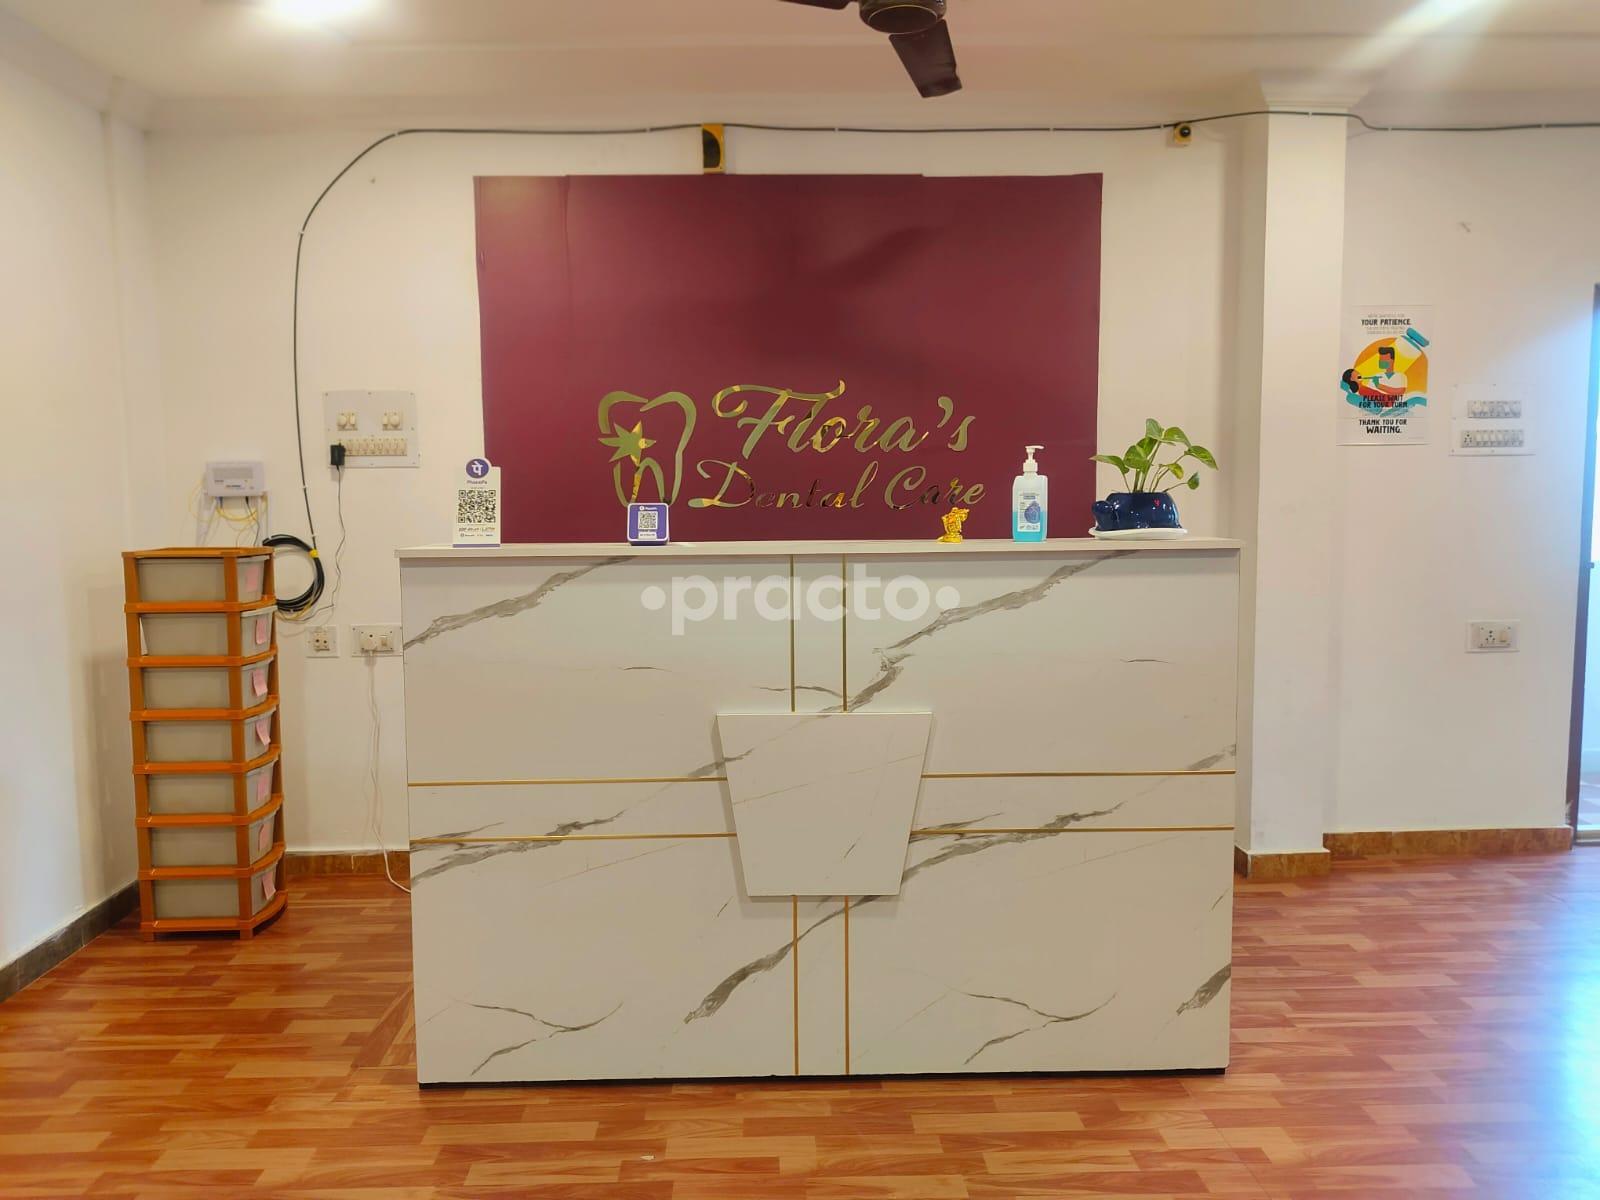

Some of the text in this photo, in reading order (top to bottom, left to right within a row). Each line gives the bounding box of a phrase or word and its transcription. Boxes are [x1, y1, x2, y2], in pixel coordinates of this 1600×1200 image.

[711, 379, 976, 460] Flora's
[688, 459, 986, 509] Dental Care
